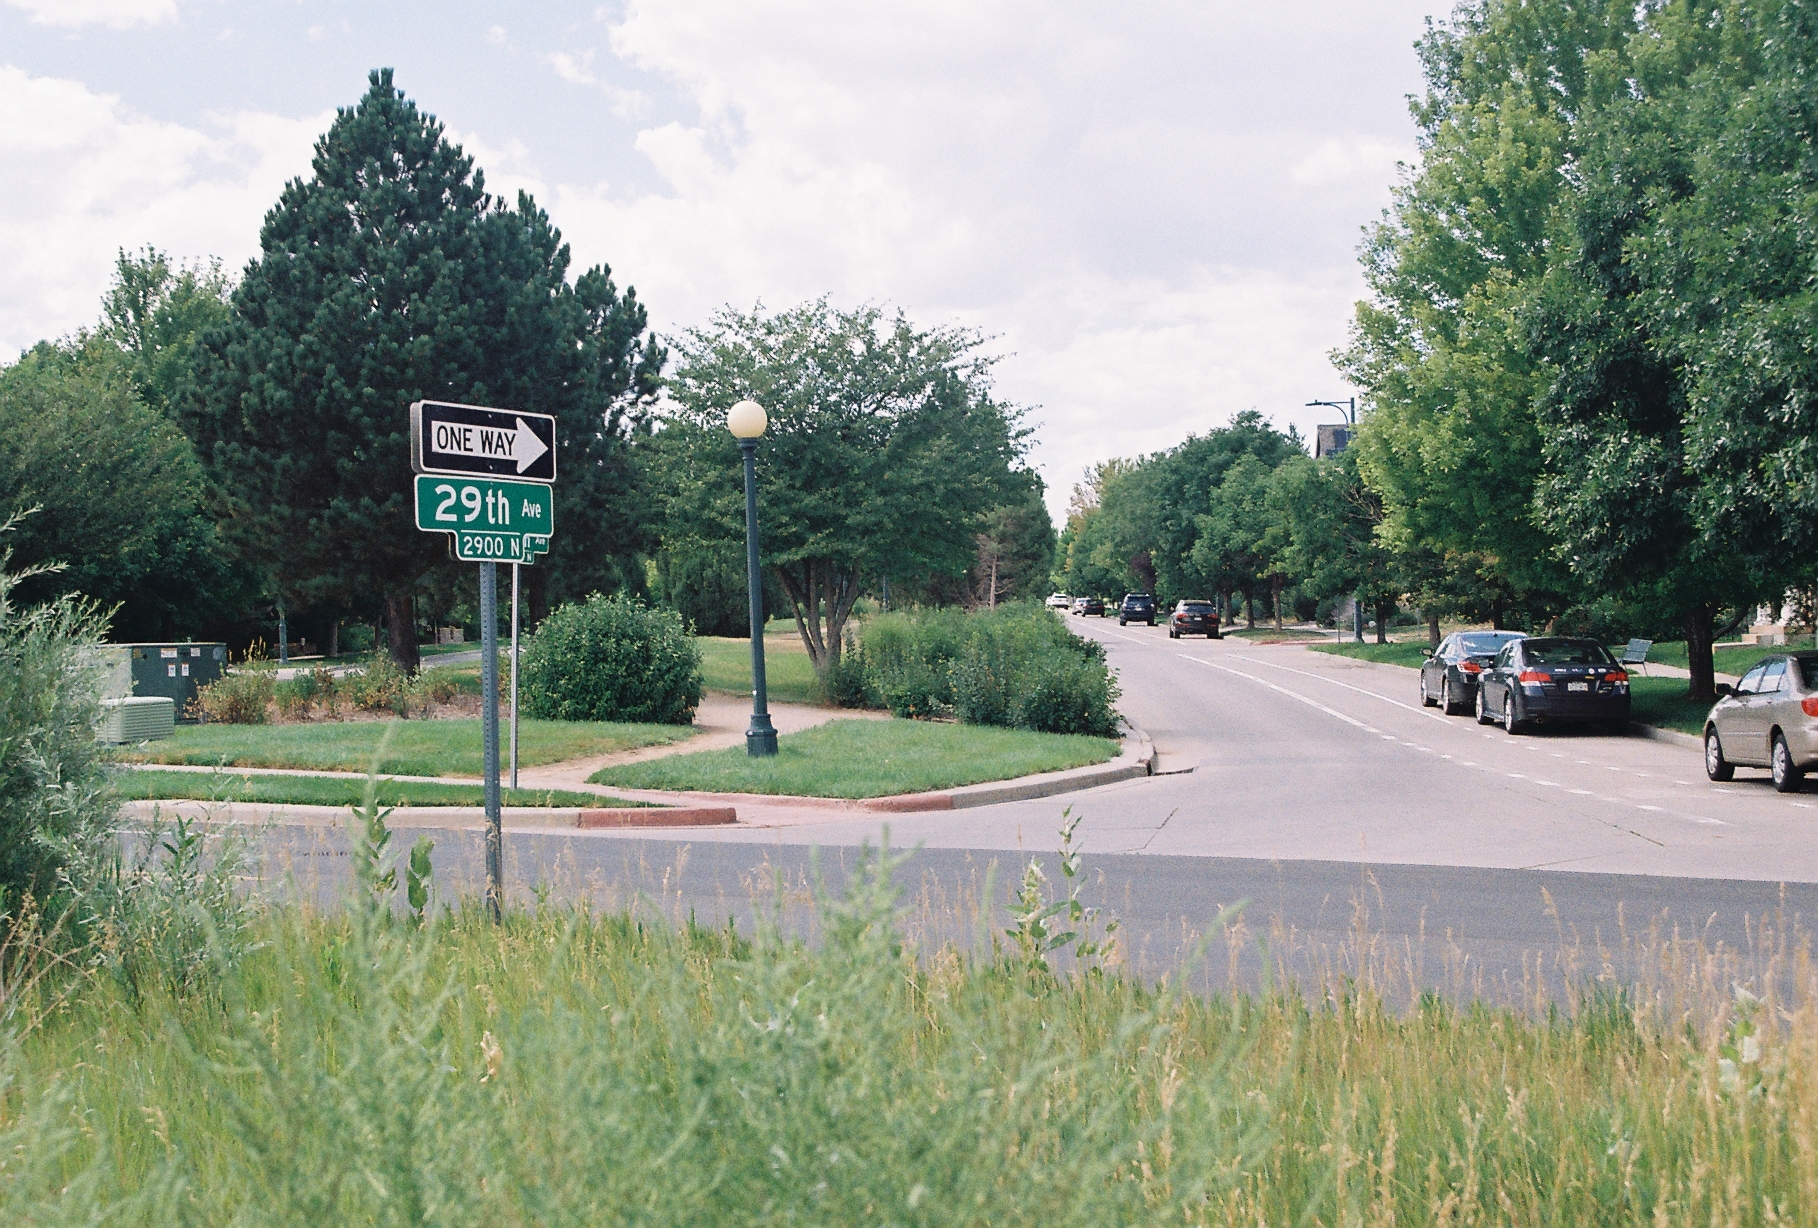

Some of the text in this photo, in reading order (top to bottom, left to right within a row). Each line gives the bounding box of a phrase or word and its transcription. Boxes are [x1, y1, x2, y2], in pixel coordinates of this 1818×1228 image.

[436, 425, 516, 456] ONE WAY
[434, 484, 542, 525] 29th Ave
[463, 536, 504, 556] 2900
[510, 537, 520, 557] N
